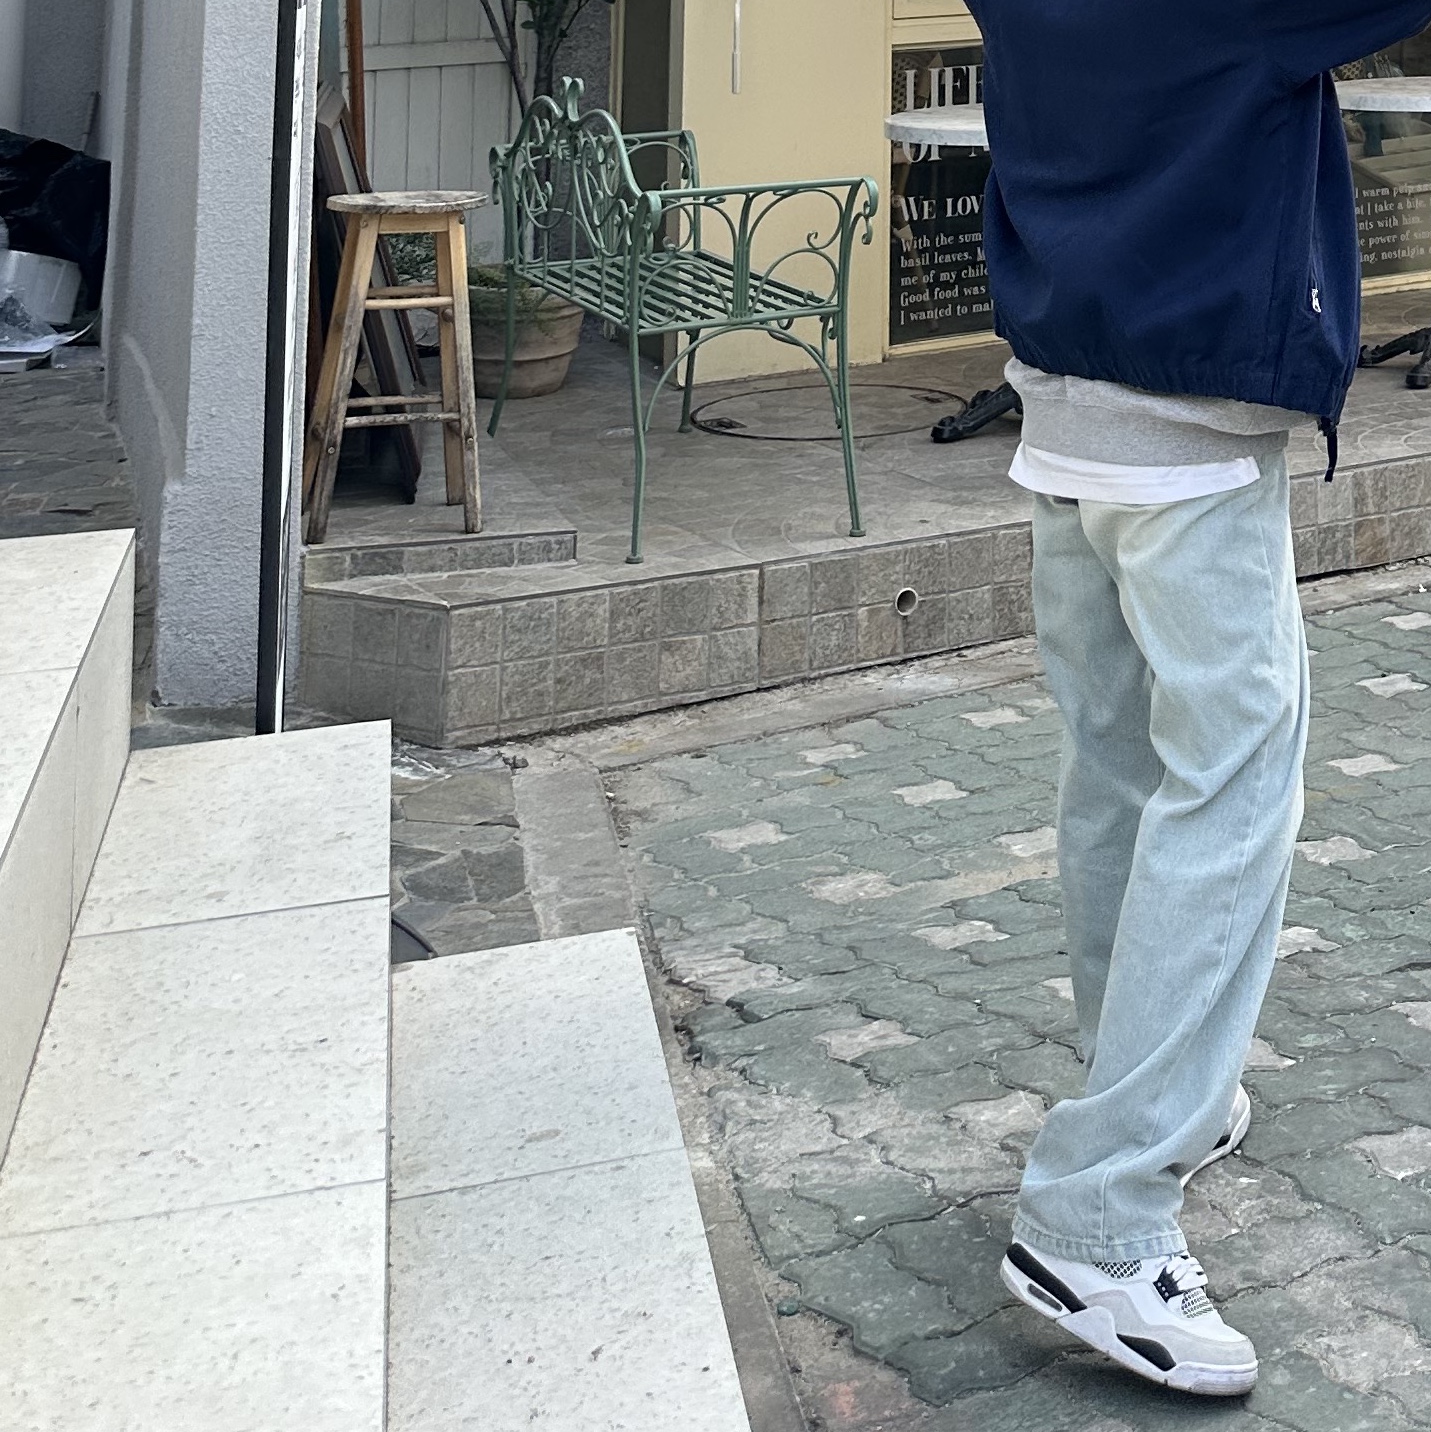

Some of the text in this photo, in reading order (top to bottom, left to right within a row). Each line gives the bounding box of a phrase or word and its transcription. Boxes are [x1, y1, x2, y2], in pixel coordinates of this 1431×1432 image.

[1362, 187, 1390, 198] warm
[901, 194, 984, 221] WE LOV
[1374, 199, 1395, 214] take
[1397, 201, 1404, 210] a
[1377, 214, 1399, 228] with
[901, 232, 983, 253] With the sum
[1368, 234, 1398, 248] power
[1400, 229, 1411, 241] of
[900, 252, 930, 268] basil
[934, 251, 973, 264] leaves.
[1381, 244, 1425, 261] nostalgia
[900, 276, 919, 286] me
[922, 269, 936, 283] of
[939, 271, 957, 284] my
[900, 284, 986, 308] Good food was
[900, 310, 905, 325] I
[909, 303, 952, 321] wanted
[956, 303, 969, 315] to
